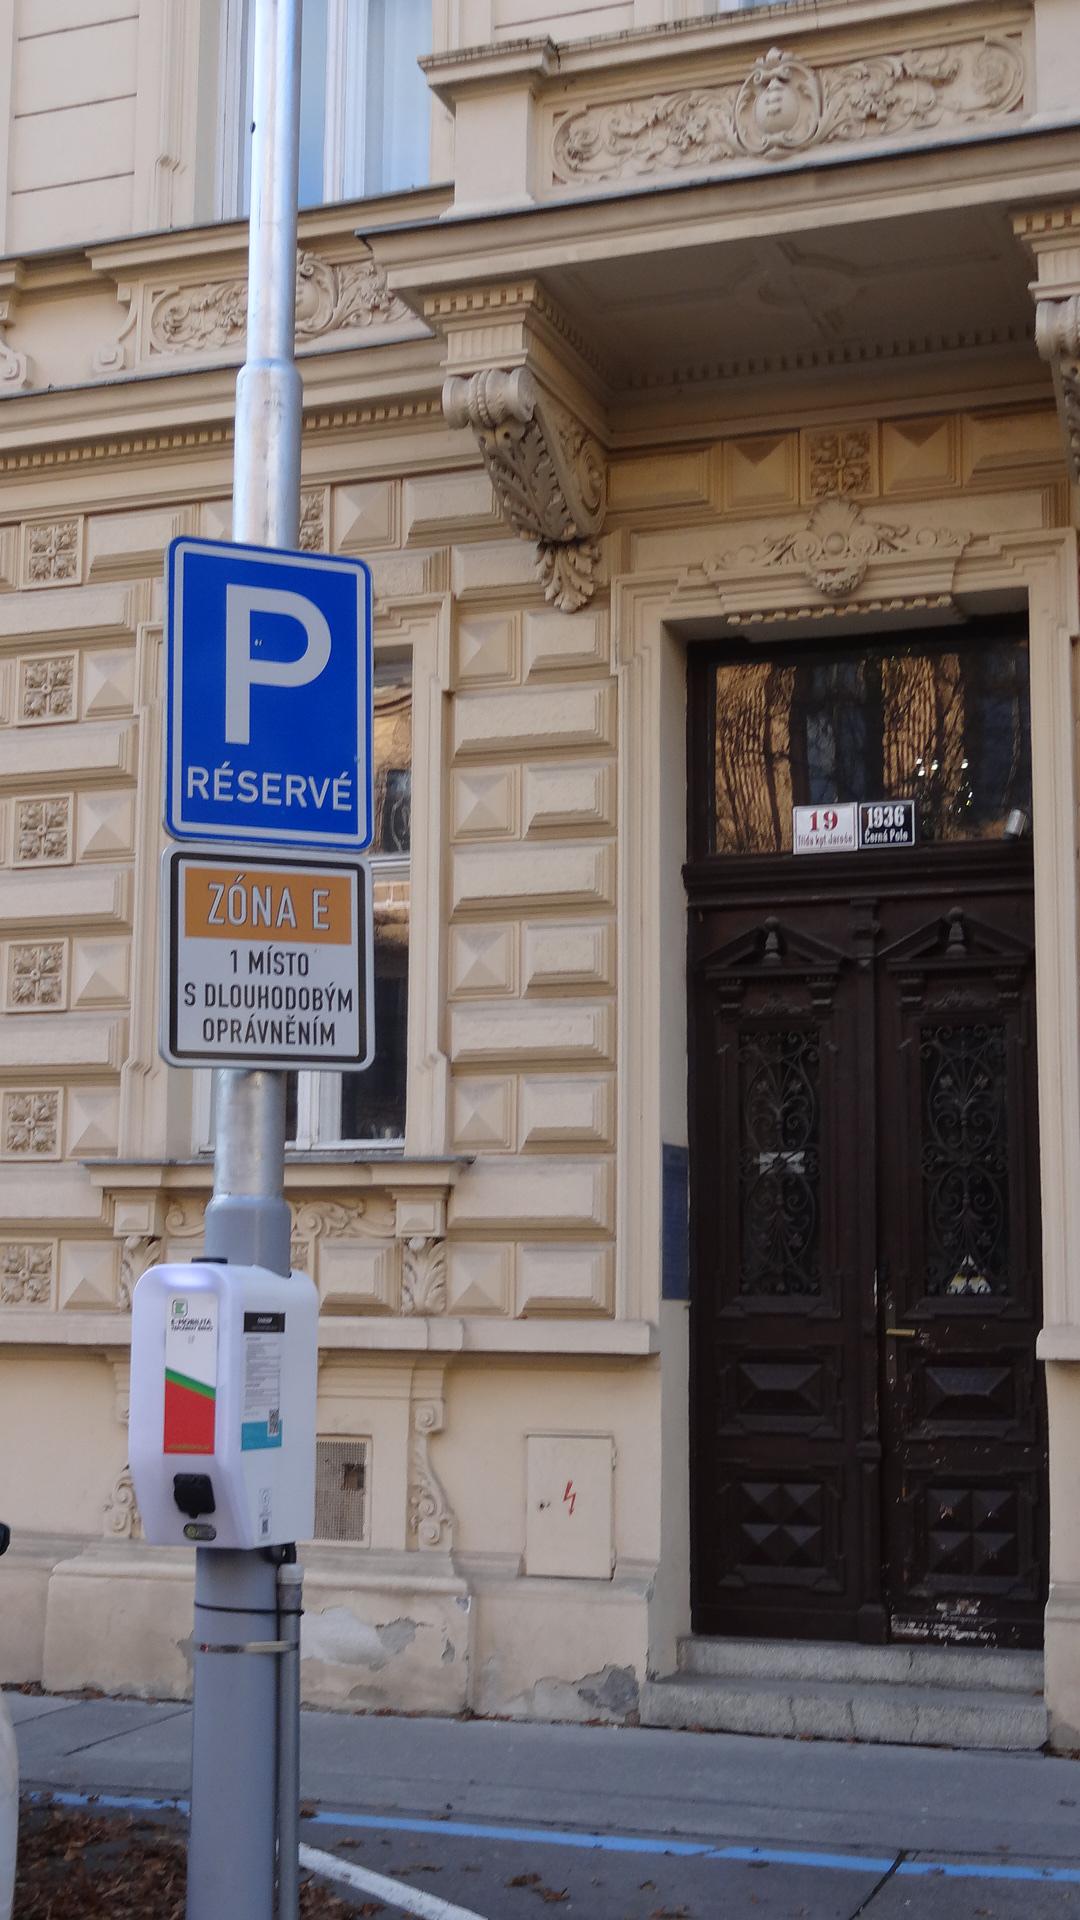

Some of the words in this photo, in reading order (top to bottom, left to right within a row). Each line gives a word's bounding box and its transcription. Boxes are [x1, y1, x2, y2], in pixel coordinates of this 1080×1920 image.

[225, 583, 332, 745] P
[186, 761, 352, 812] RÉSERVÉ
[809, 810, 839, 832] 19
[866, 805, 905, 828] 1936
[206, 872, 298, 930] ZÓNA
[312, 888, 332, 931] E
[229, 950, 239, 975] 1
[248, 945, 310, 978] MÍSTO
[183, 983, 197, 1008] S
[204, 982, 354, 1014] DLOUHODOBÝM
[202, 1015, 337, 1047] OPRÁVNĚNÍM
